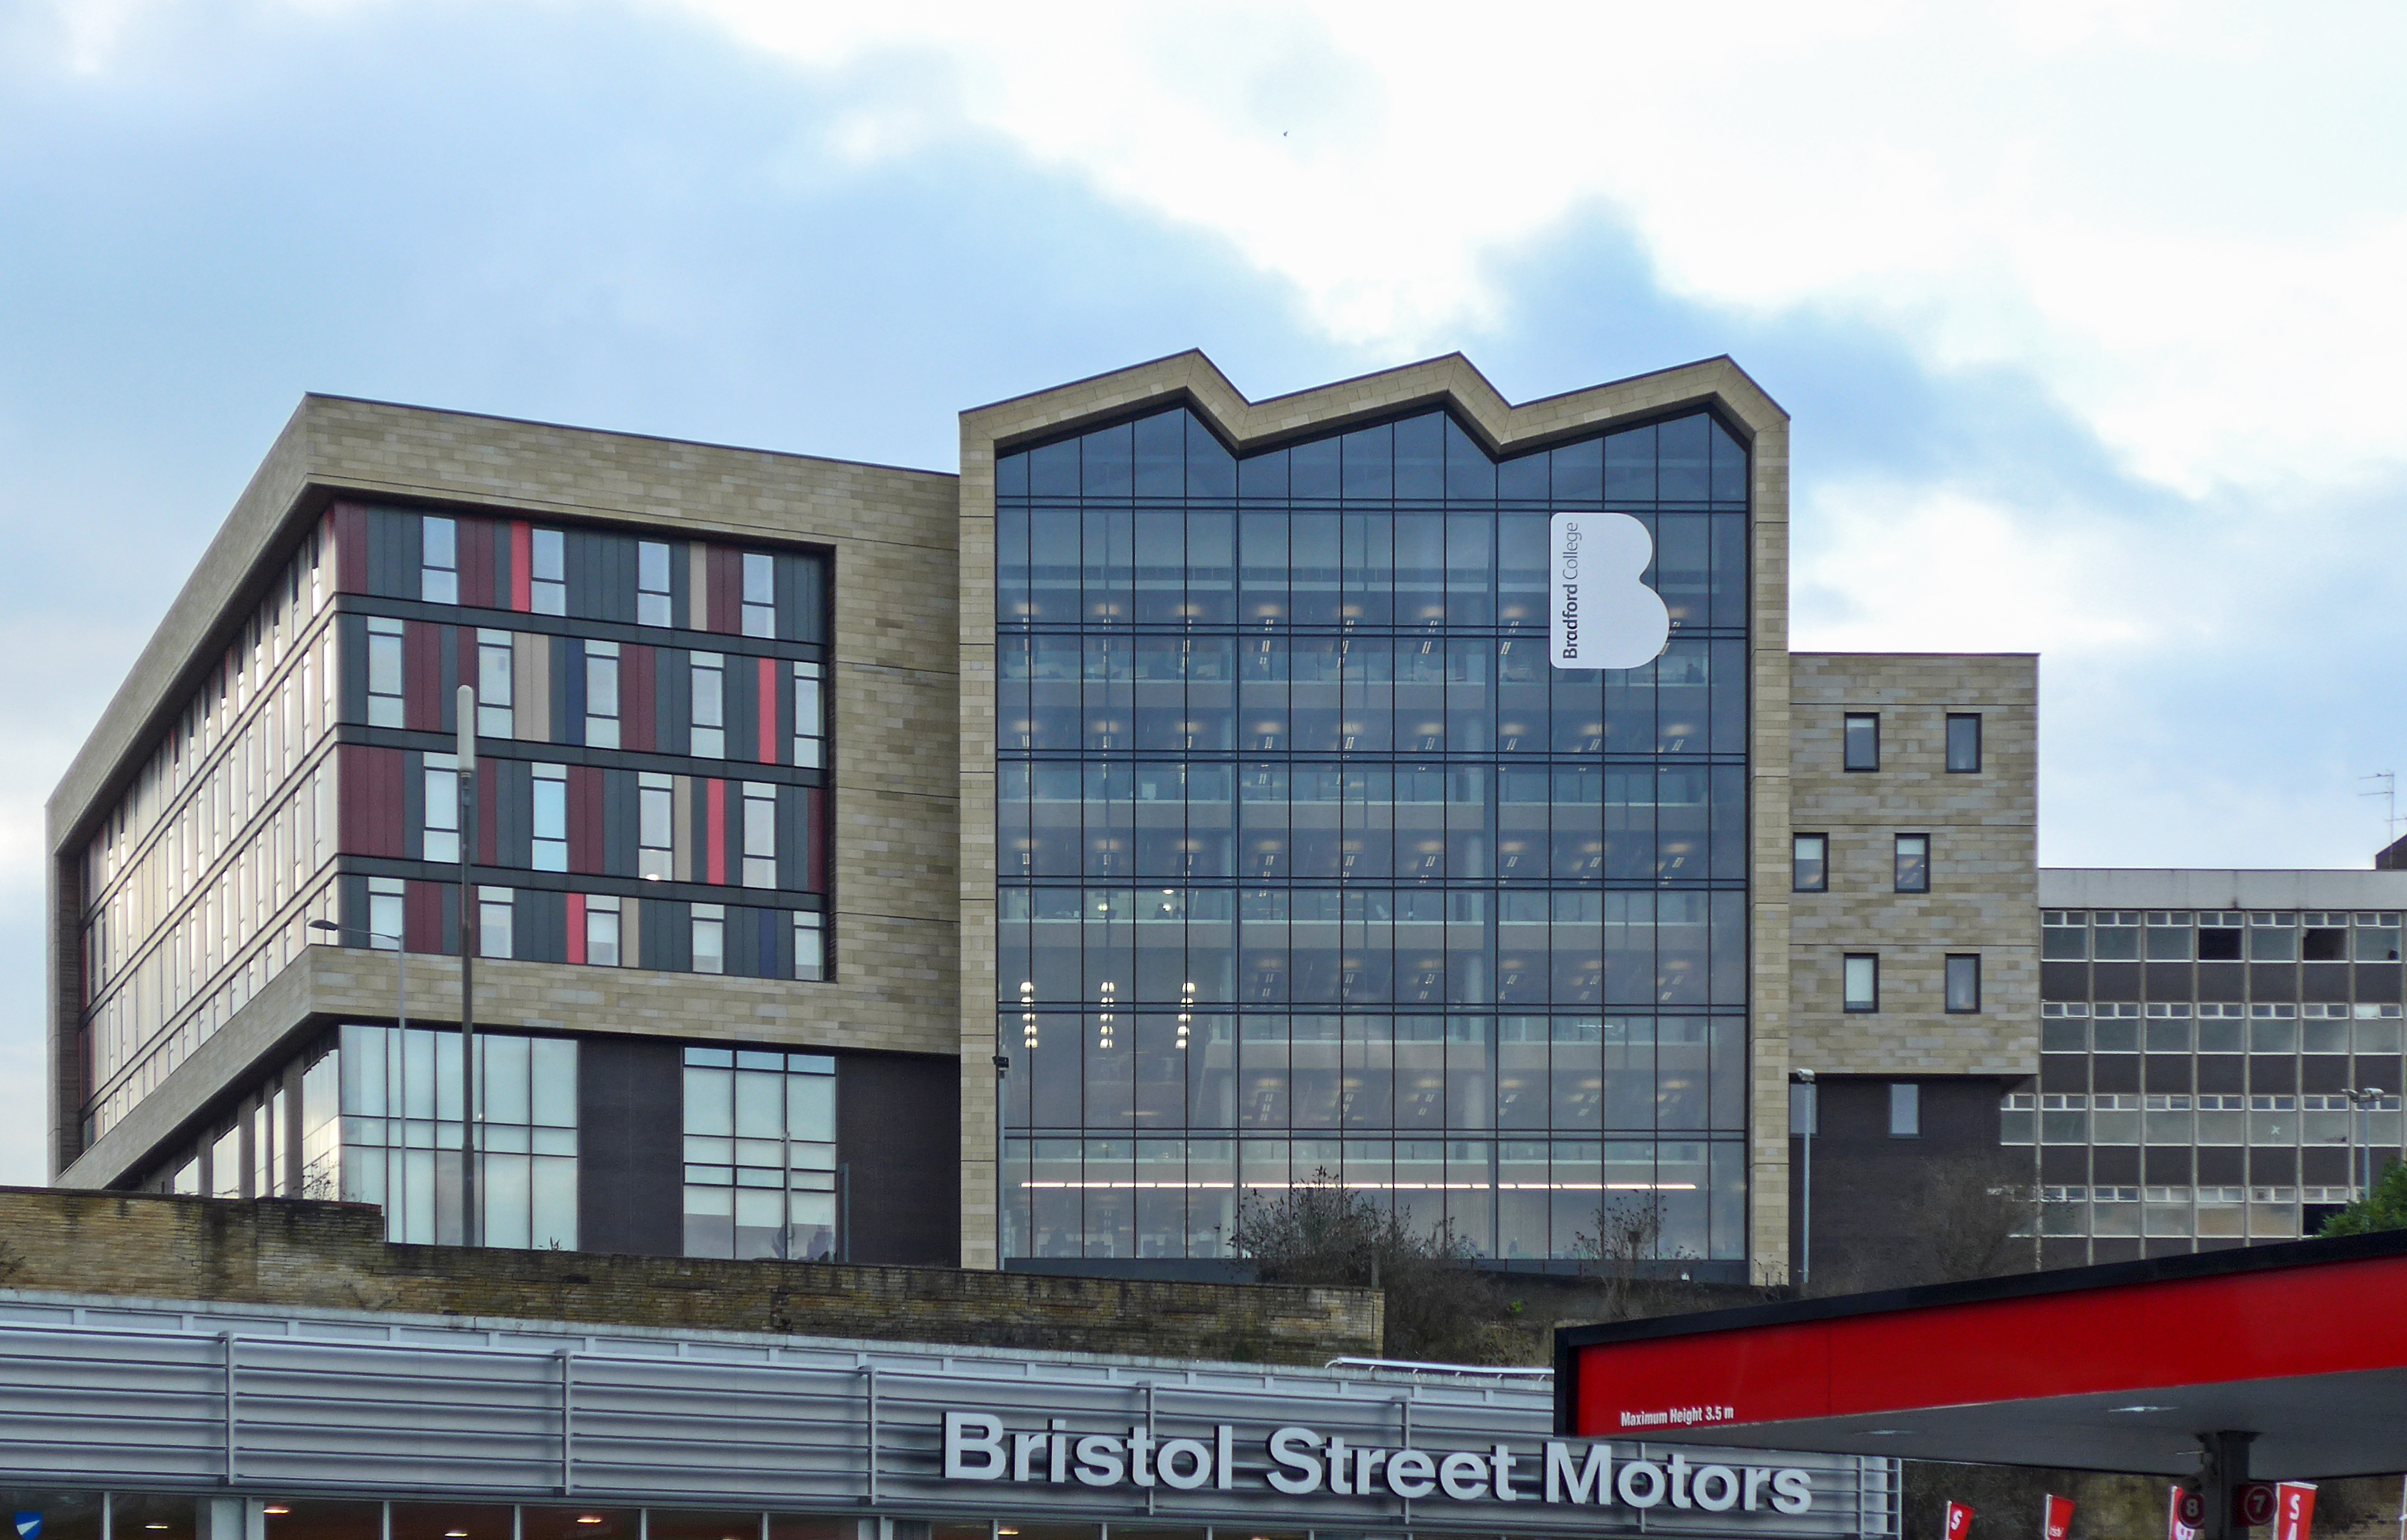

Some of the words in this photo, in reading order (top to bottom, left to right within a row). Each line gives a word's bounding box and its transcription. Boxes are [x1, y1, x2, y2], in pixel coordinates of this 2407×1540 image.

[1562, 522, 1582, 580] College
[1562, 584, 1578, 659] Bradford
[1621, 1411, 1668, 1426] Maximum
[1669, 1406, 1703, 1425] Height
[1706, 1406, 1722, 1421] 3.5
[1723, 1406, 1734, 1419] m
[943, 1411, 1233, 1490] Bristol
[1266, 1426, 1518, 1501] Street
[1543, 1441, 1813, 1515] Motors
[2186, 1499, 2199, 1517] 8
[2253, 1494, 2266, 1514] 7
